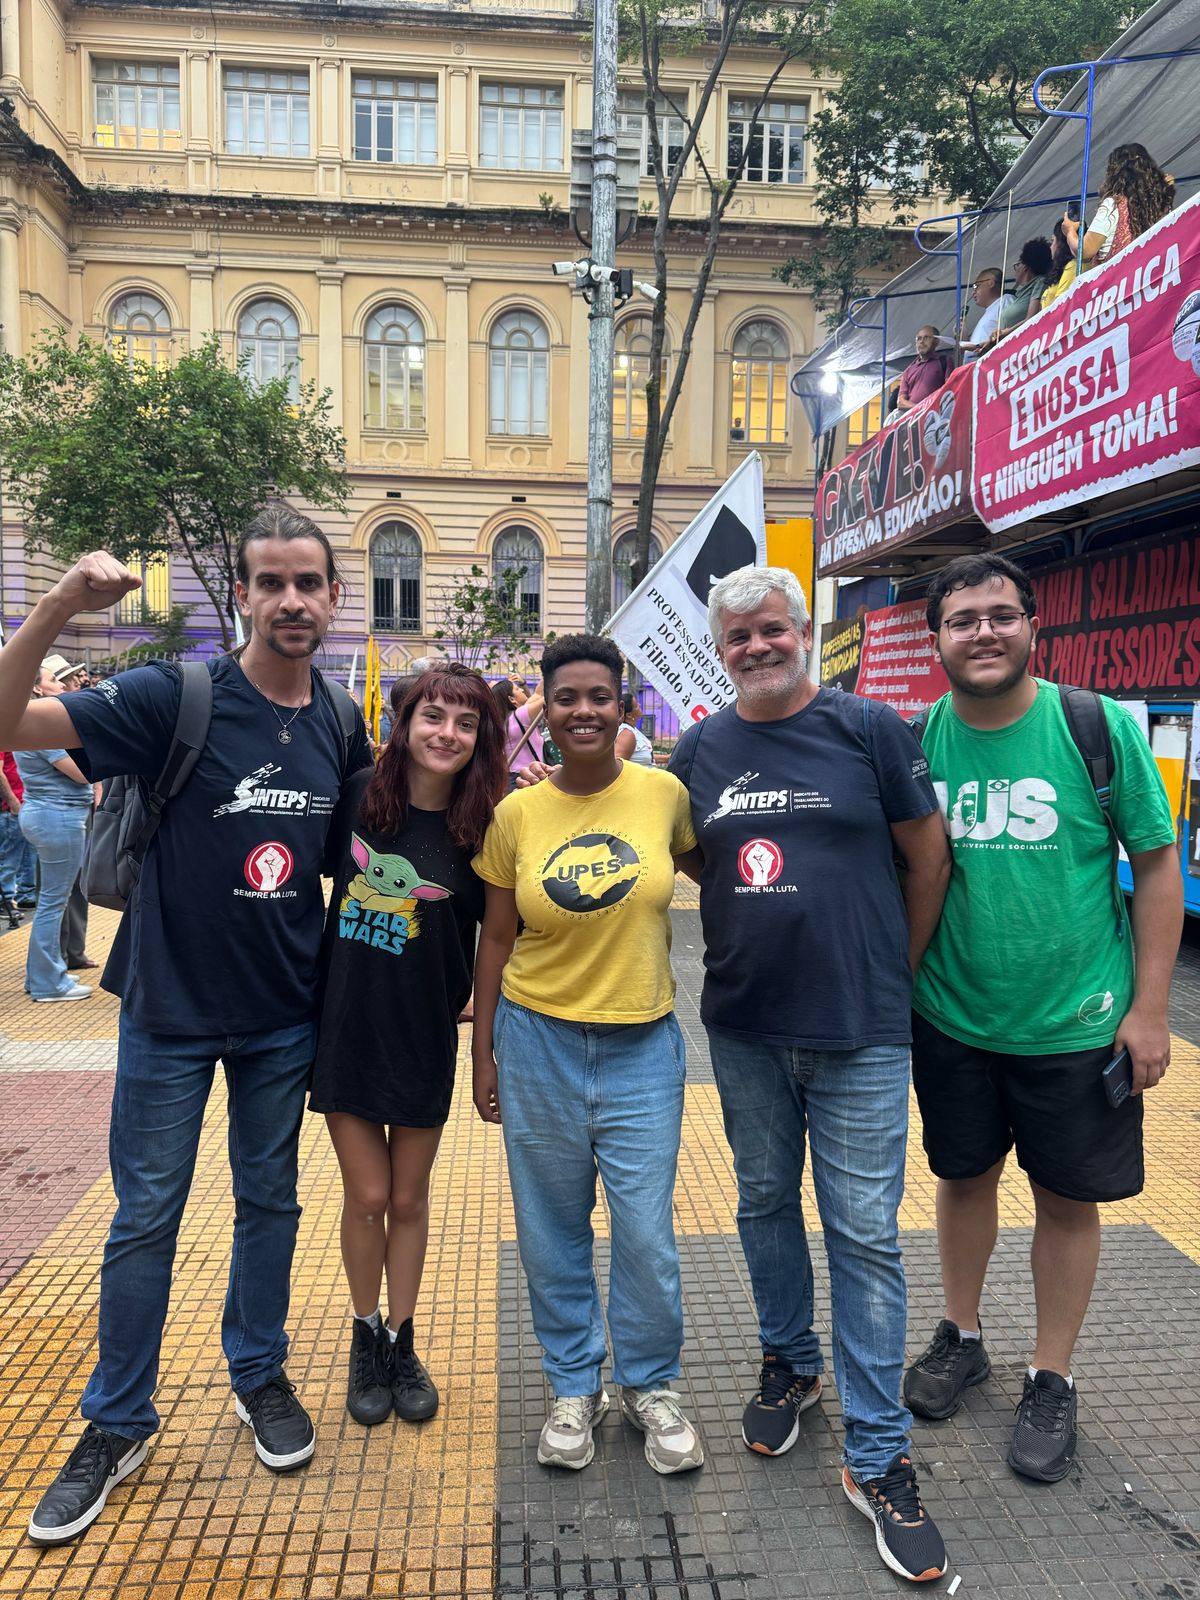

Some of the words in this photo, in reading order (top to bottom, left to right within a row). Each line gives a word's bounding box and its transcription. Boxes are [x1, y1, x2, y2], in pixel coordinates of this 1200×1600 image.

[986, 369, 998, 405] A
[999, 323, 1063, 396] ESCOLA
[1067, 243, 1181, 348] PÚBLICA
[1016, 388, 1029, 441] É
[1033, 346, 1119, 434] NOSSA
[981, 473, 992, 508] E
[995, 430, 1084, 503] NINGUÉM
[1090, 387, 1178, 464] TOMA!
[823, 411, 926, 539] GREVE!
[833, 527, 865, 562] DEFESA
[864, 515, 882, 545] DA
[647, 588, 718, 677] PROFESSORES
[715, 675, 735, 696] DO
[657, 623, 676, 645] DO
[674, 644, 713, 695] ESTADO
[638, 635, 683, 693] Filiado
[682, 692, 692, 707] à
[228, 776, 308, 814] SINTEPS
[712, 783, 789, 816] SINTEPS
[558, 858, 621, 880] UPES
[762, 885, 775, 893] NA
[776, 885, 798, 893] LUTA
[233, 888, 269, 899] SEMPRE
[270, 891, 281, 899] NA
[281, 889, 297, 898] LUTA
[339, 918, 407, 955] WARS
[340, 899, 409, 937] STAR
